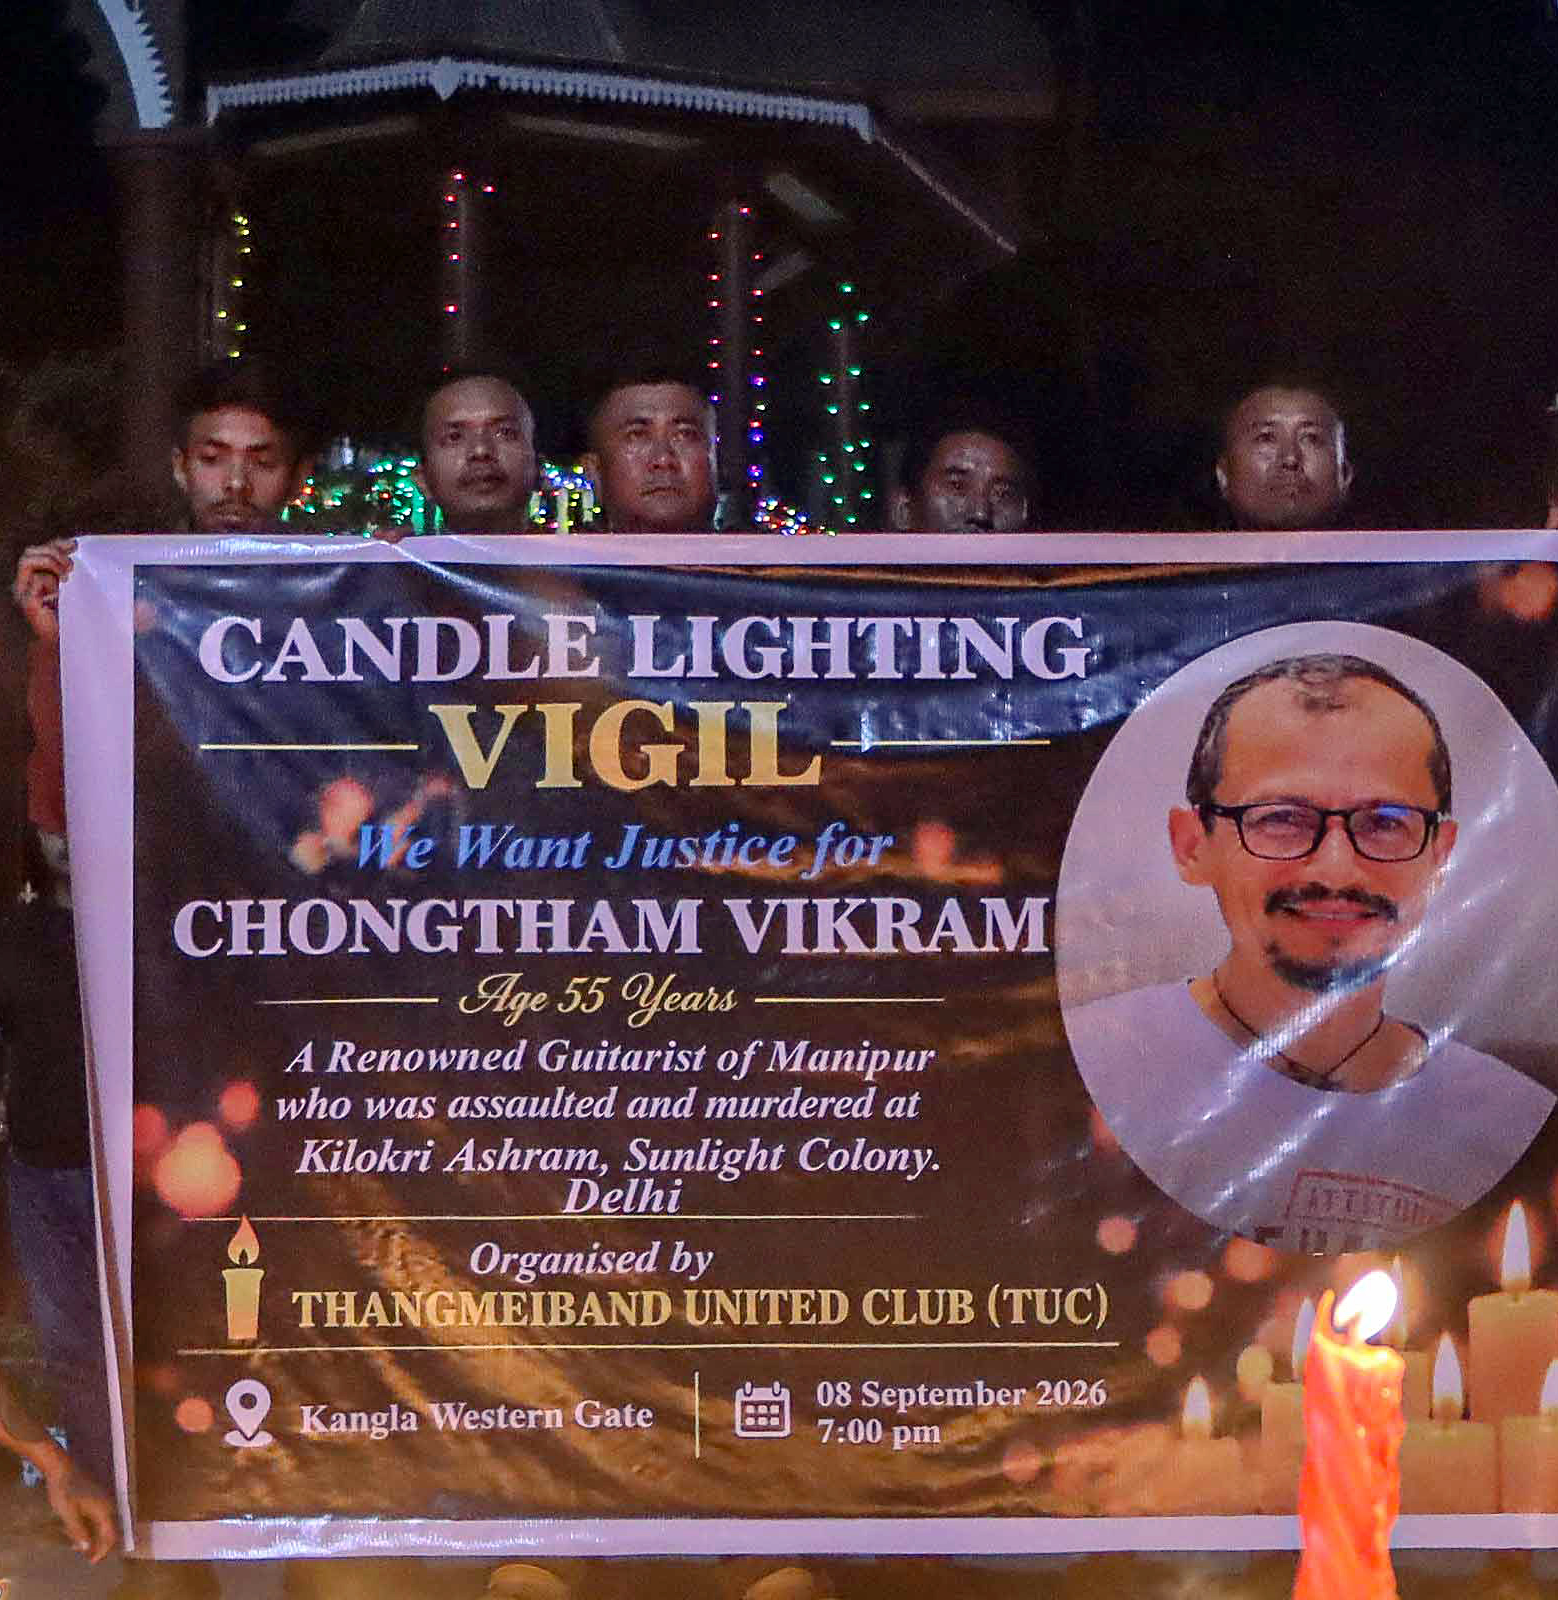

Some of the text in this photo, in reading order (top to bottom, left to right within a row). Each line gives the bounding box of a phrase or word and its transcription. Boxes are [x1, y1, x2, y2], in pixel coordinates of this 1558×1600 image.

[199, 614, 1091, 683] CANDLE LIGHTING
[429, 700, 822, 792] VIGIL
[356, 821, 896, 880] We Want Justice for
[173, 897, 1050, 957] CHONGTHAM VIKRAM
[459, 972, 737, 1028] Age 55 Years
[284, 1039, 936, 1081] A Renowned Guitarist of Manipur
[276, 1086, 922, 1120] who was assaulted and murdered at
[294, 1137, 940, 1182] Kilokri Ashram, Sunlight Colony.
[562, 1178, 684, 1214] Delhi
[469, 1241, 714, 1283] Organised by
[292, 1283, 1109, 1330] THANGMEIBAND UNITED CLUB (TUC)
[300, 1378, 1108, 1440] Kangla Western Gate 08 September 2026
[818, 1418, 941, 1450] 7:00 pm
